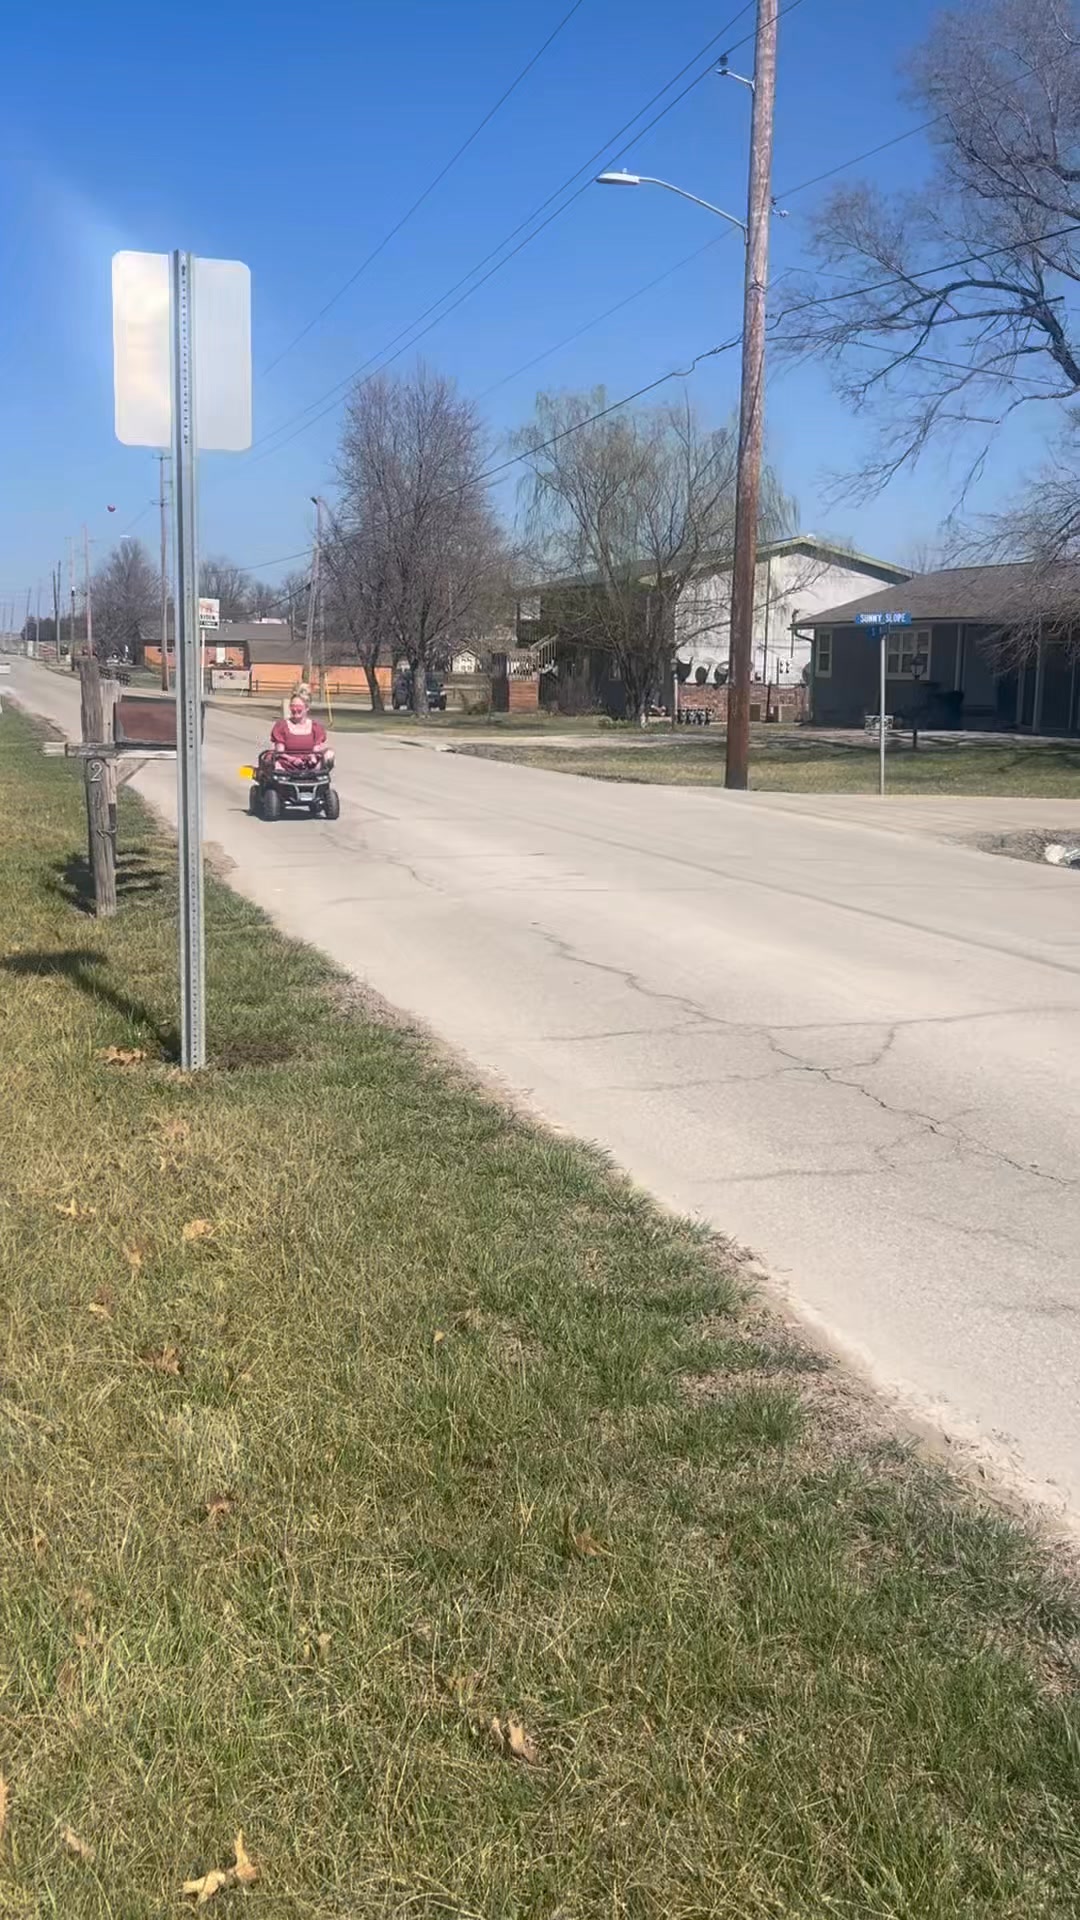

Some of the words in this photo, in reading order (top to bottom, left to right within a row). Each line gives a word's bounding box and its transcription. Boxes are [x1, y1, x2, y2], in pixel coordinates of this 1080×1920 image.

[860, 614, 882, 624] SUNNY
[885, 613, 906, 623] SLOPE
[90, 762, 102, 782] 2
